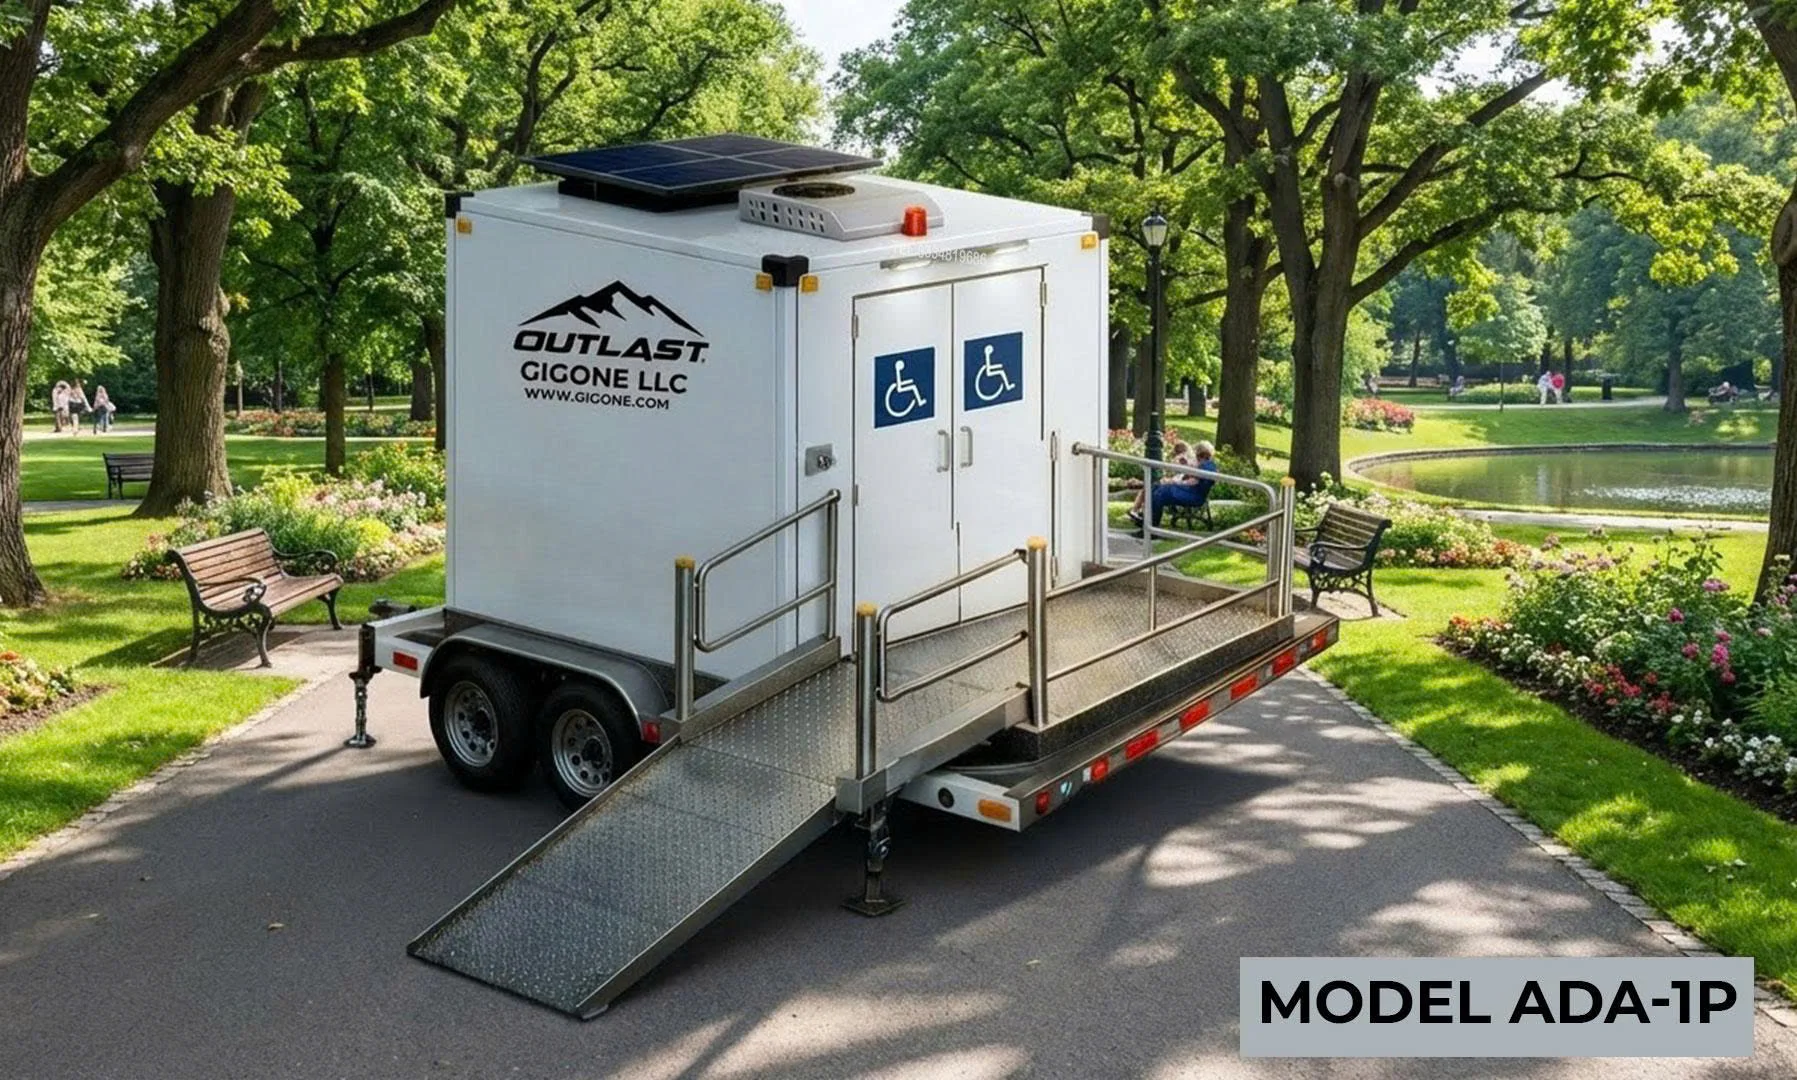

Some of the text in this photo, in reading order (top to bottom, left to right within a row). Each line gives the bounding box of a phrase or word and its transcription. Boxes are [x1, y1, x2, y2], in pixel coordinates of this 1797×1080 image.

[513, 329, 710, 364] OUTLAST
[520, 360, 689, 395] GIGONE LLC
[524, 387, 670, 411] WWW.GIGONE.COM
